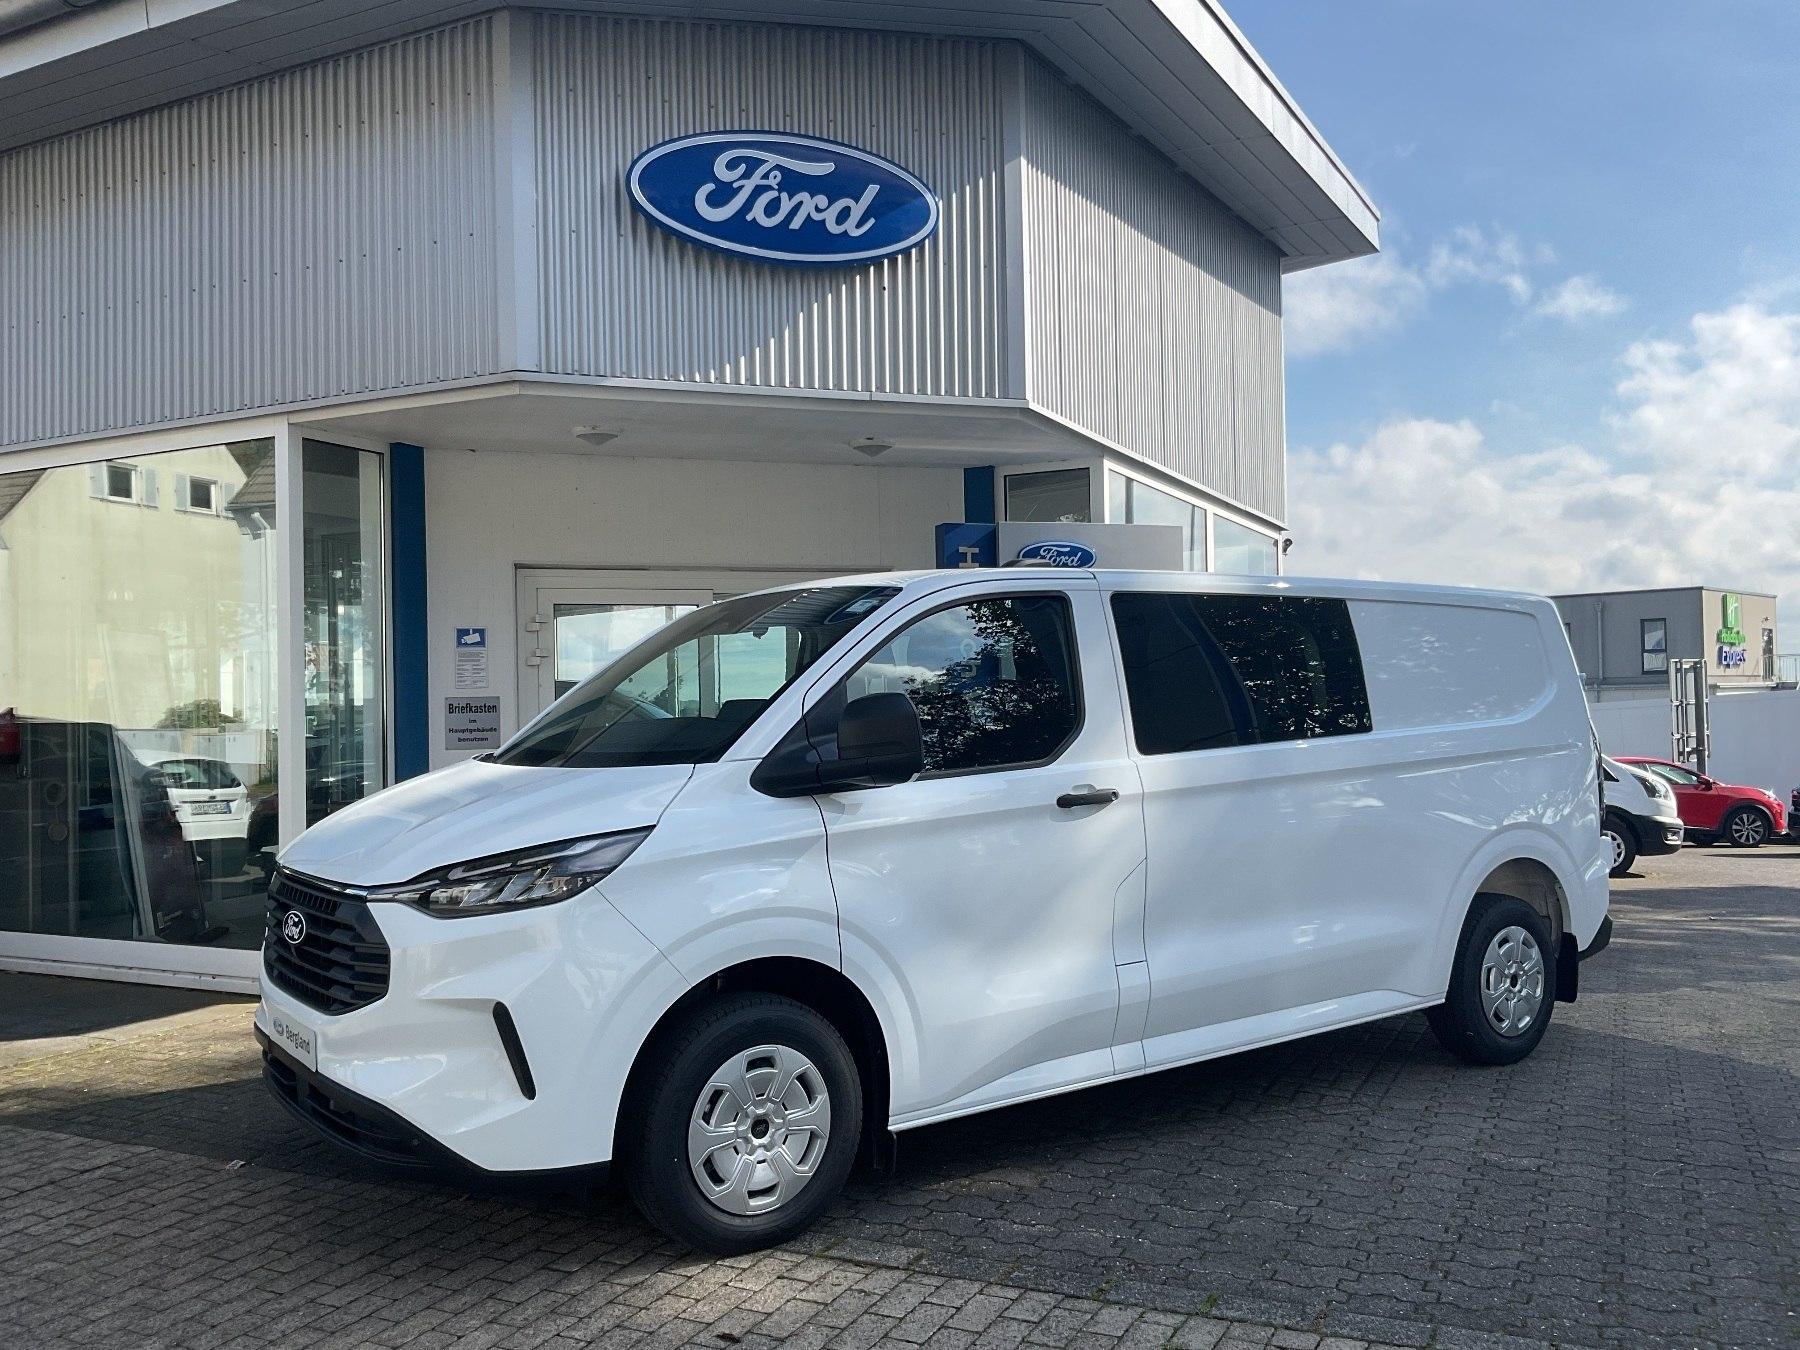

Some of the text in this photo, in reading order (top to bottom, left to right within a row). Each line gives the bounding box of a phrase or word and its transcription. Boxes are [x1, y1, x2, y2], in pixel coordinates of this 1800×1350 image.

[694, 148, 880, 237] Ford
[448, 703, 498, 714] Briefkasten
[448, 727, 498, 736] Hauptgebäude
[284, 914, 302, 940] Ford
[285, 1024, 311, 1055] Bergland
